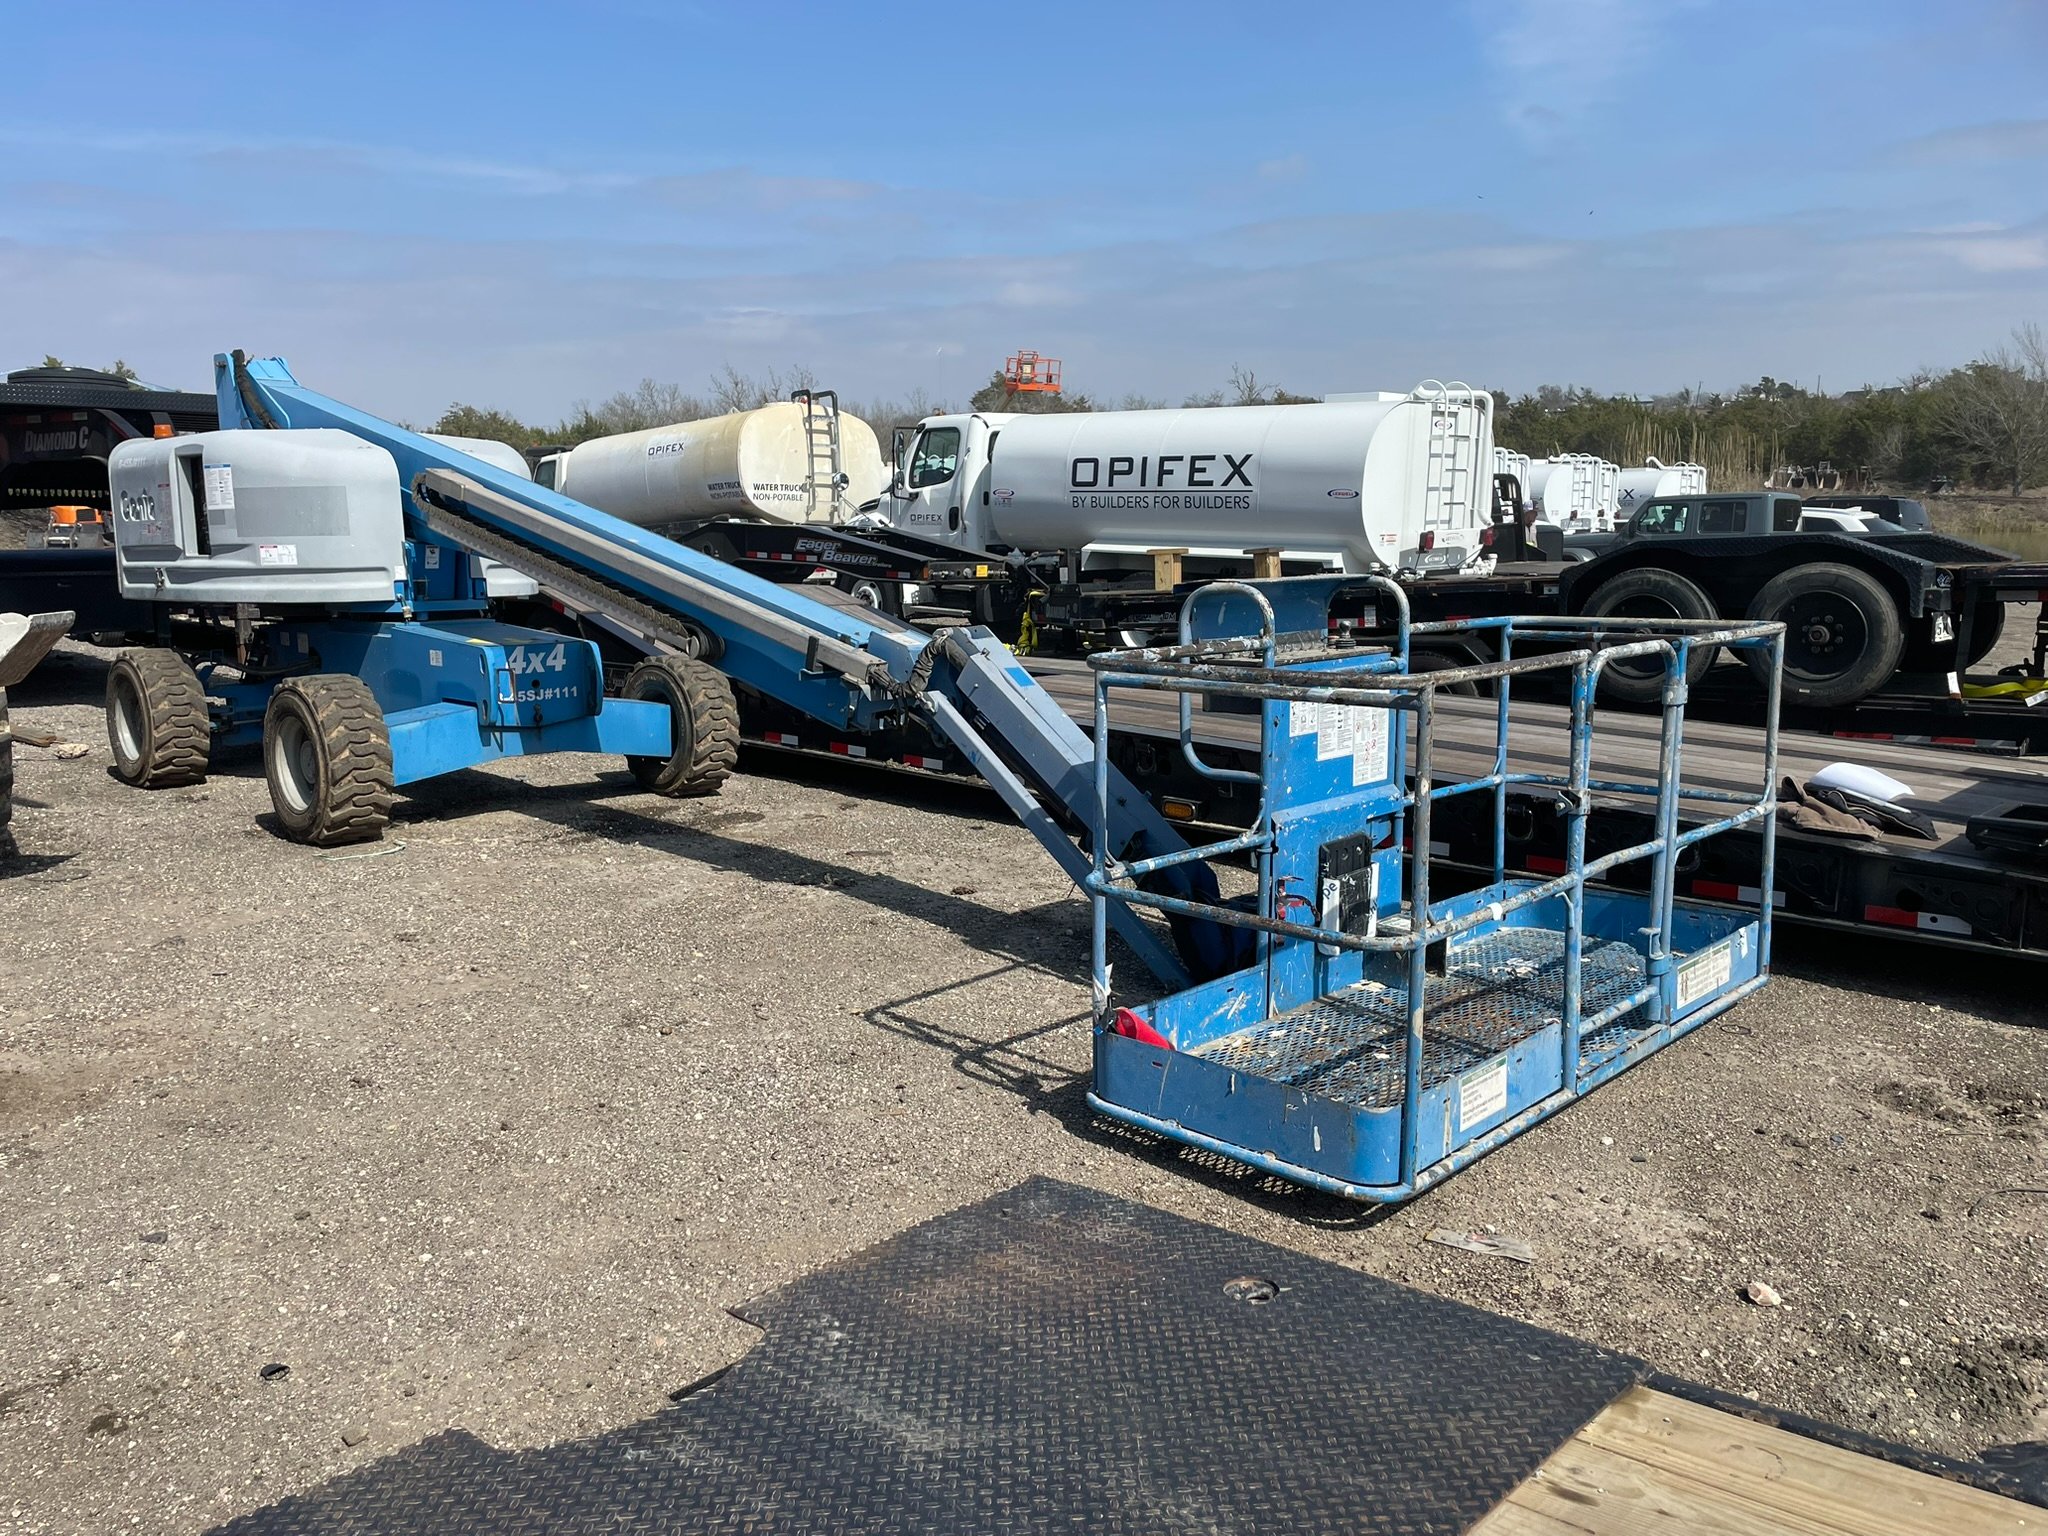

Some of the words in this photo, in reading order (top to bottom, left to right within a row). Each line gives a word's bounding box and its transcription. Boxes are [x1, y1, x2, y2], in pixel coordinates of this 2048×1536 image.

[24, 431, 77, 453] DIAMOND
[79, 426, 88, 449] C
[648, 442, 684, 456] OPIFEX
[1071, 453, 1254, 488] OPIFEX
[753, 483, 779, 492] WATER
[752, 493, 803, 501] NON-POTABLE
[1072, 496, 1087, 509] BY
[1091, 496, 1149, 509] BUILDERS
[1153, 496, 1181, 509] FOR
[1184, 496, 1250, 509] BUILDERS
[120, 488, 155, 522] Genie
[910, 514, 943, 522] OPIFEX
[795, 539, 841, 552] Eager
[821, 550, 878, 565] Beaver
[508, 643, 567, 675] 4x4
